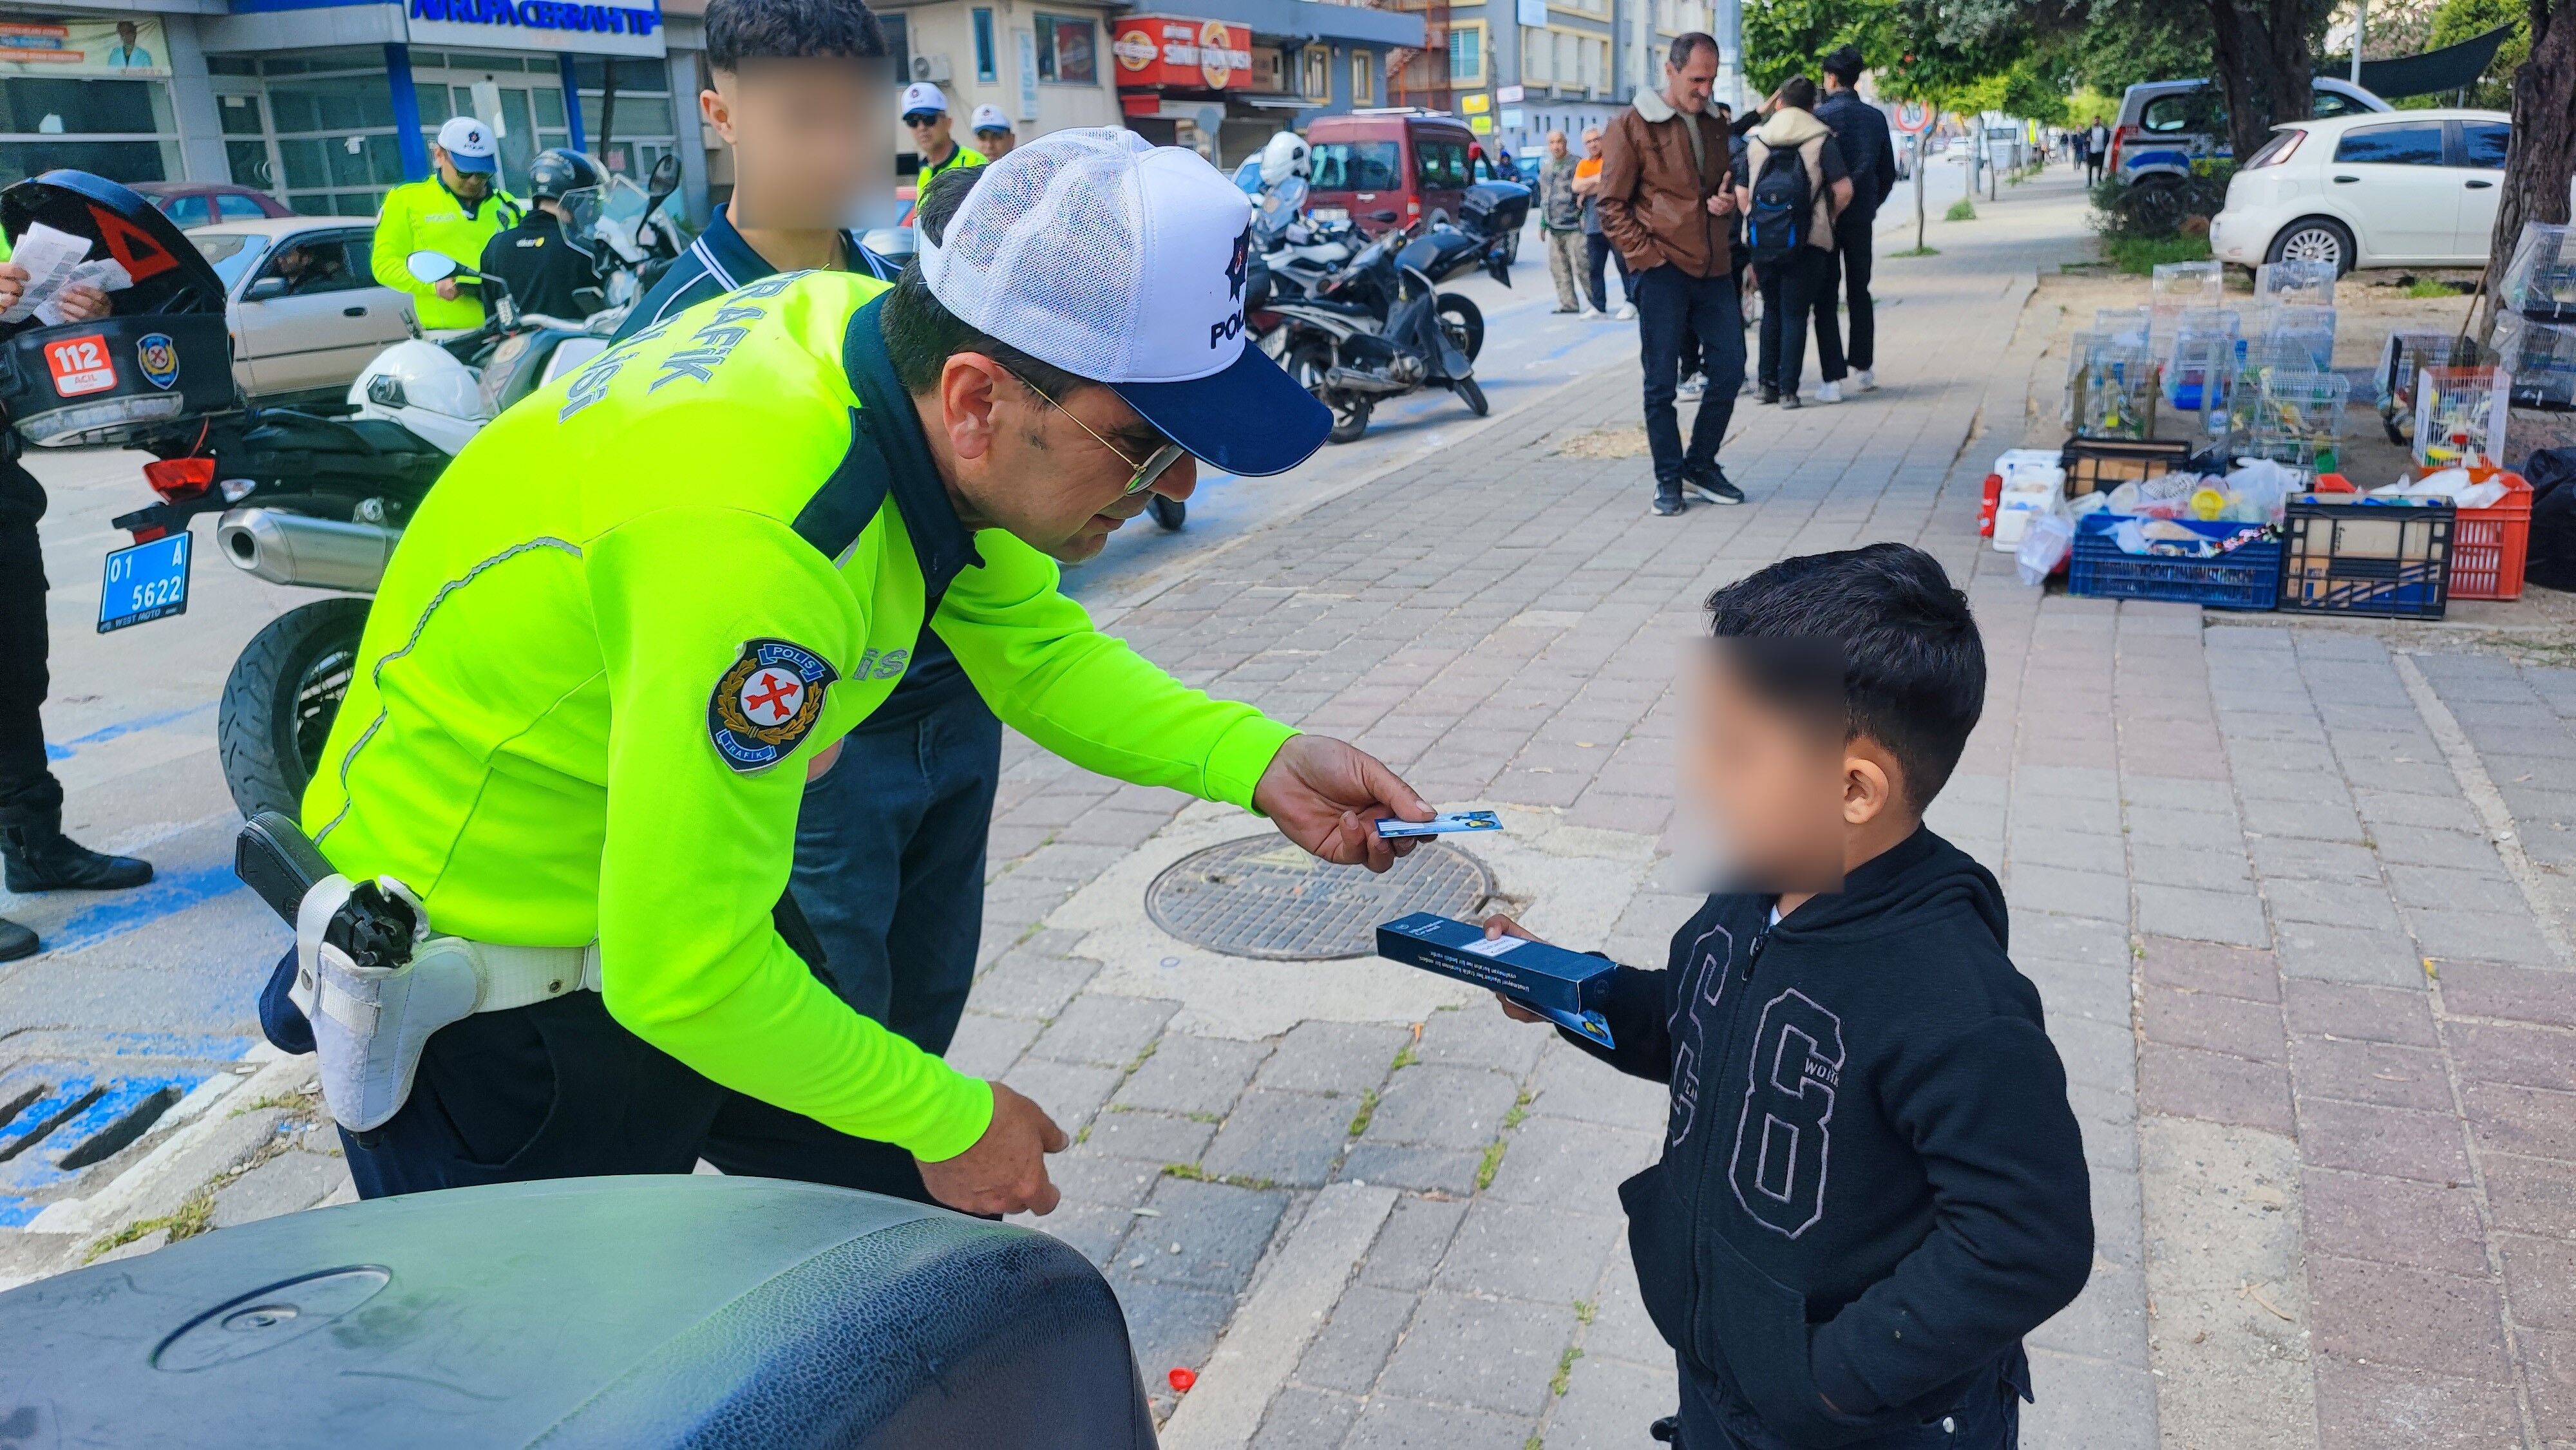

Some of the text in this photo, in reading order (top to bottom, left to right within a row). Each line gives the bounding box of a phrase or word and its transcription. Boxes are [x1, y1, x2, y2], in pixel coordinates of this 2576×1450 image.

[1211, 309, 1244, 349] POL
[55, 343, 102, 372] 112
[110, 540, 182, 583] 01 A
[131, 575, 181, 611] 5622
